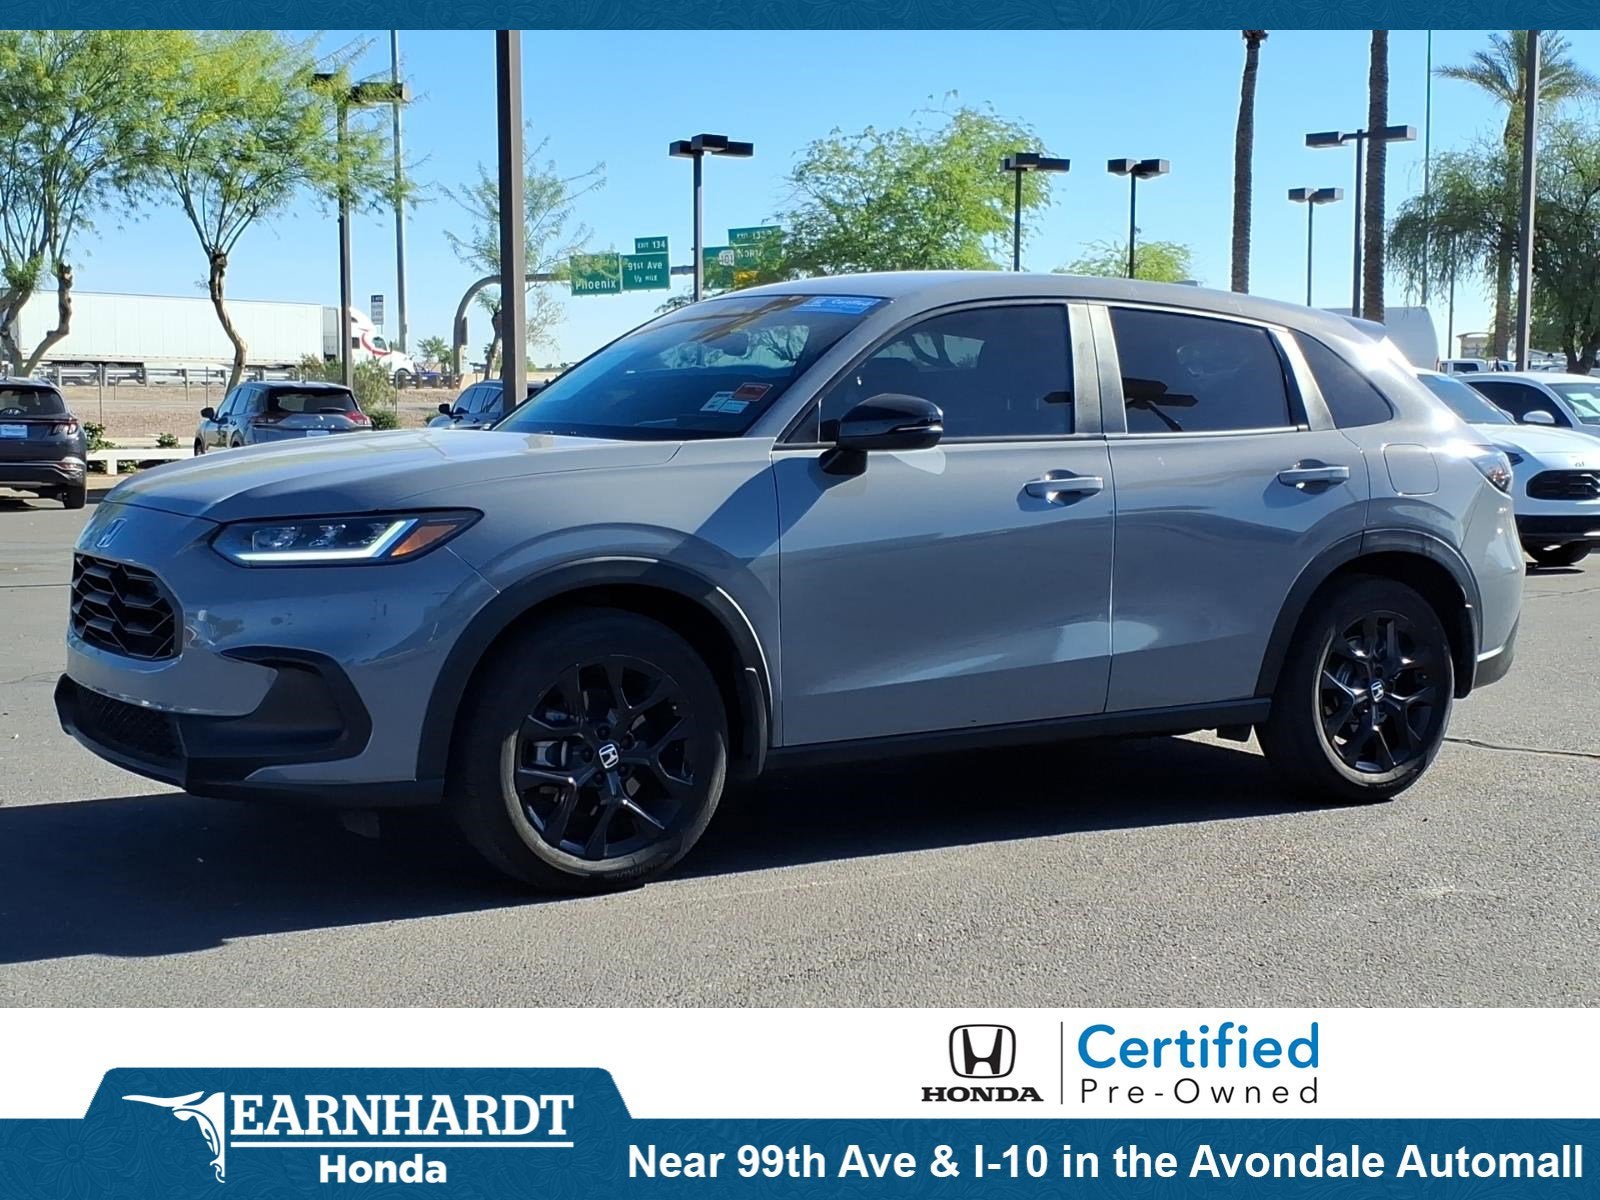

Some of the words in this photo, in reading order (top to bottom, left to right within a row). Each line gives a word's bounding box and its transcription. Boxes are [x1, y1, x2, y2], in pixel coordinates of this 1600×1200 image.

[652, 240, 666, 249] 134
[627, 261, 644, 271] 91st
[647, 261, 663, 270] Ave
[575, 279, 617, 291] Phoenix
